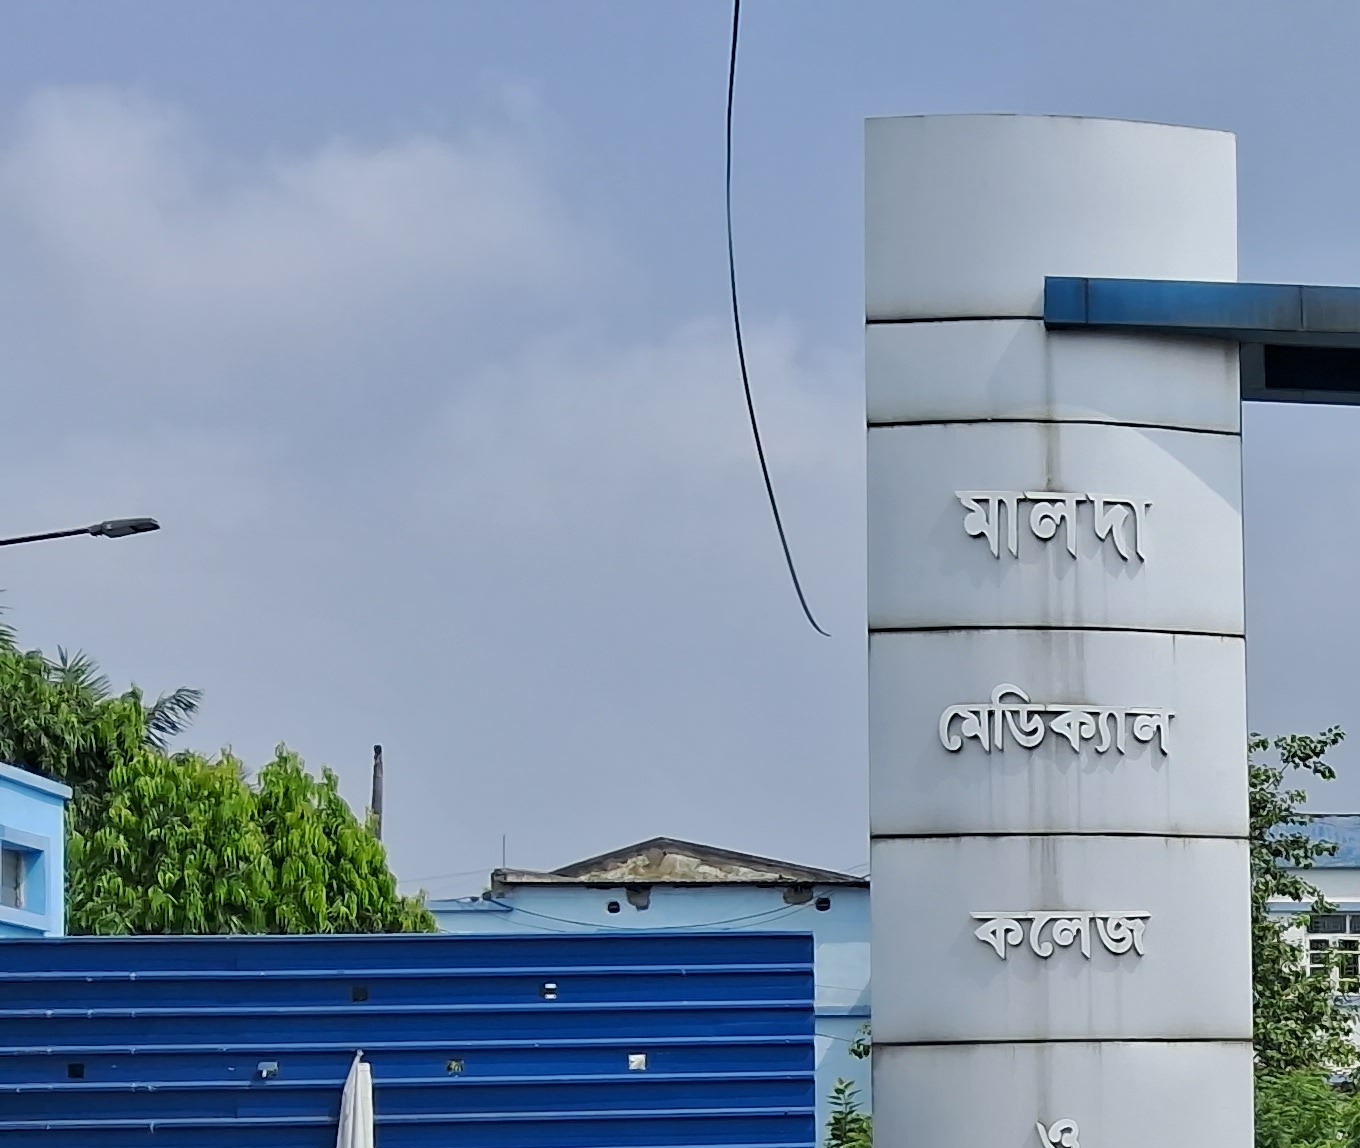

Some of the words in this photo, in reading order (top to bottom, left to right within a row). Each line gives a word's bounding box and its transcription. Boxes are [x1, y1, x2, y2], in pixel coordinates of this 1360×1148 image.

[954, 490, 1153, 562] মালদা
[939, 683, 1177, 756] মেডিক্যাল
[969, 910, 1152, 961] কলেজ
